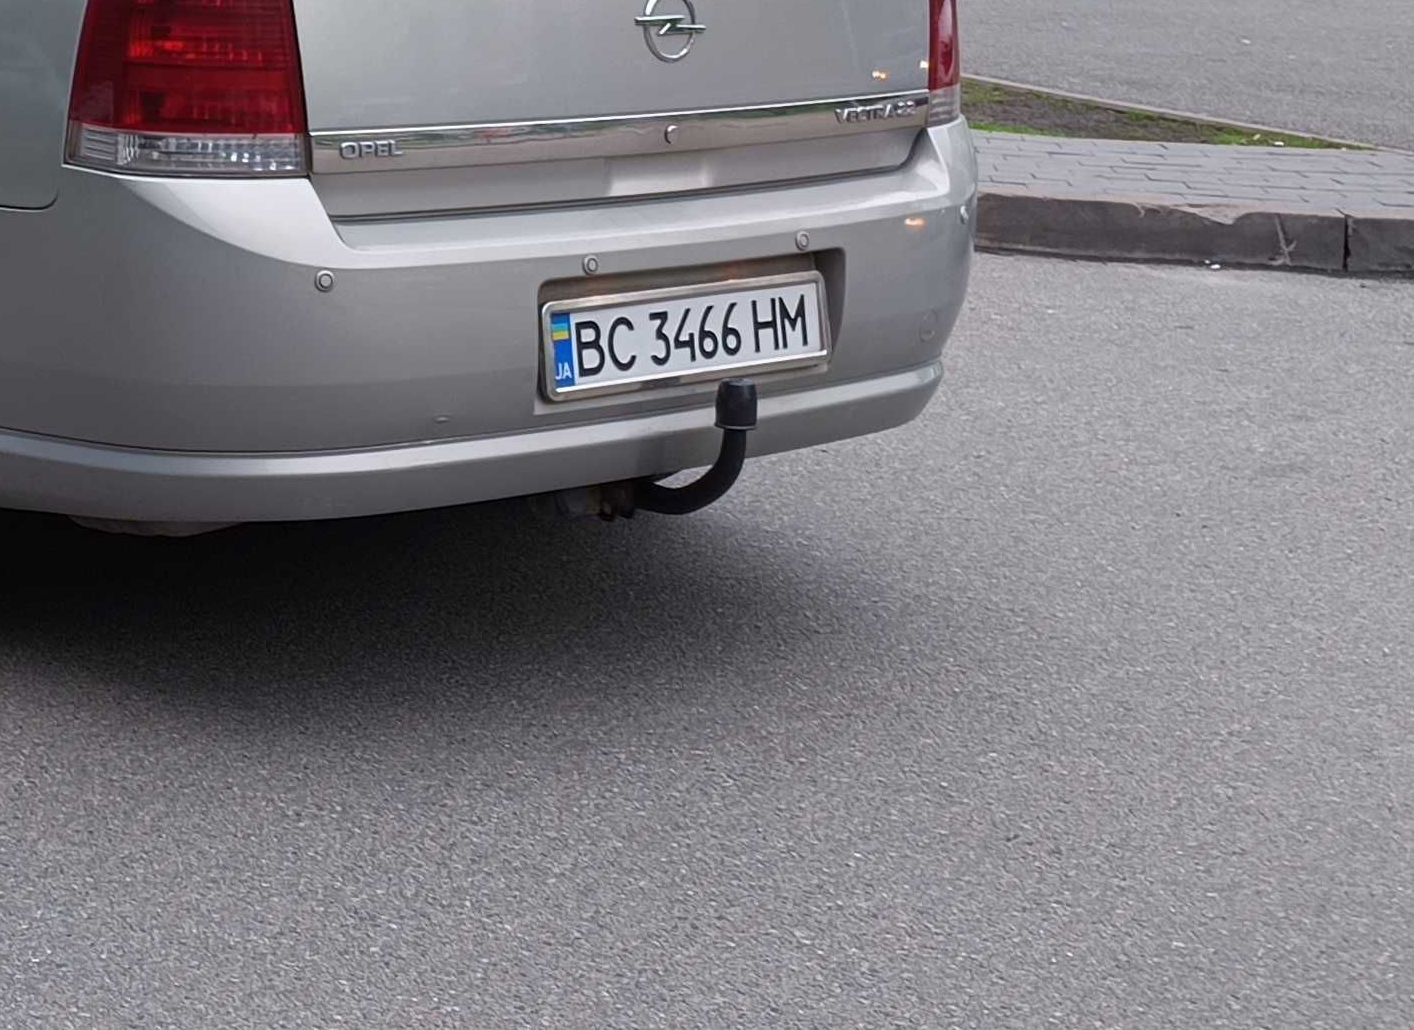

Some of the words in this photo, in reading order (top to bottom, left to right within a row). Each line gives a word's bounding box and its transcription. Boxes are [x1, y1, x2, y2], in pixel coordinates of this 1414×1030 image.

[834, 103, 895, 122] VECTRA
[339, 139, 403, 159] OPEL
[575, 317, 637, 377] BC
[649, 302, 742, 366] 3466
[752, 294, 809, 353] HM
